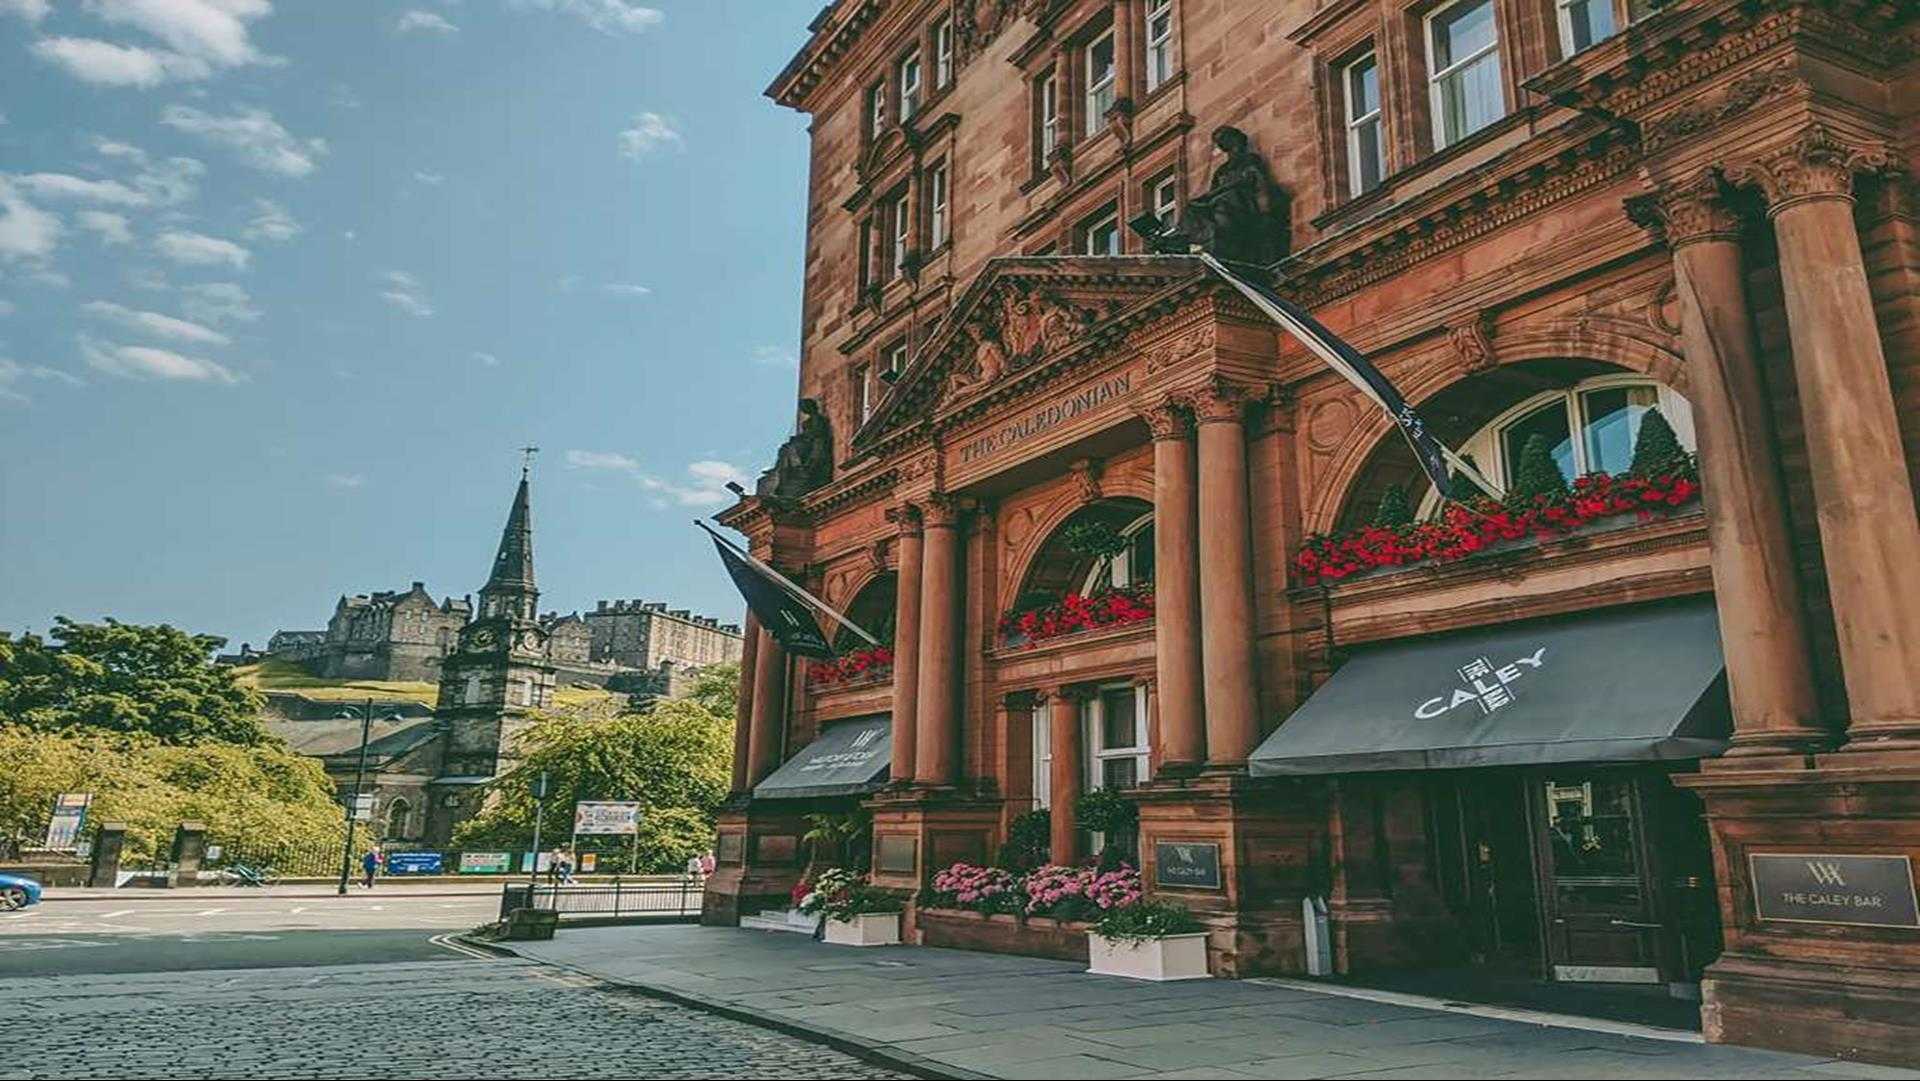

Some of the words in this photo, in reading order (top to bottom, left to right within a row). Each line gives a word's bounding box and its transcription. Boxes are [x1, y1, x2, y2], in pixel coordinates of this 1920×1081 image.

[959, 435, 998, 463] THE
[998, 371, 1131, 446] CALEDONIAN
[1414, 647, 1546, 719] CALEY
[1782, 892, 1806, 905] THE
[1807, 893, 1850, 907] CALEY
[1853, 895, 1883, 908] BAR
